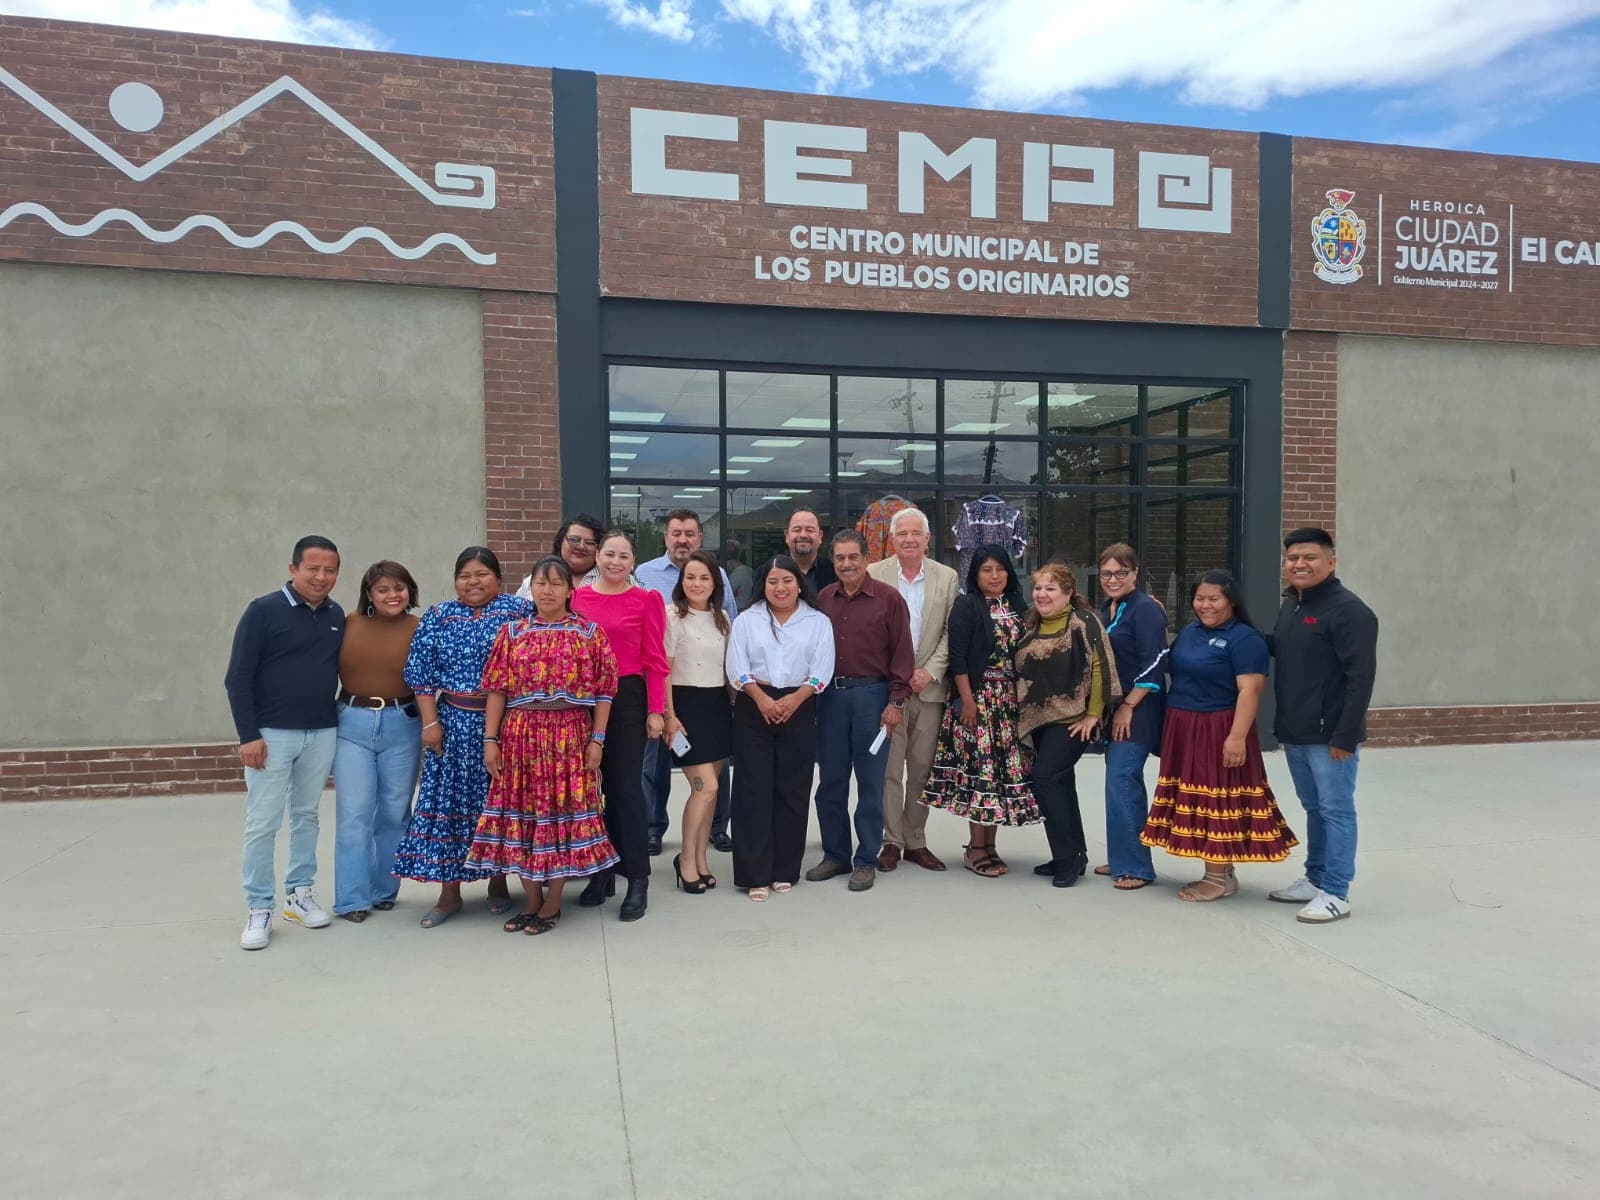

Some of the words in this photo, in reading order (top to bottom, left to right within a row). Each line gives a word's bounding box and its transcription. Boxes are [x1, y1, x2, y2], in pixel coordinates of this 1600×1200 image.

[630, 107, 1233, 234] CEMPO
[1410, 199, 1486, 216] HEROICA
[789, 224, 905, 255] CENTRO
[912, 232, 1059, 264] MUNICIPAL
[1064, 241, 1100, 266] DE
[1395, 216, 1499, 246] CIUDAD
[1394, 242, 1499, 275] JUÁREZ
[754, 255, 812, 282] LOS
[824, 259, 951, 290] PUEBLOS
[957, 267, 1131, 298] ORIGINARIOS
[1393, 275, 1425, 286] Gobierno
[1425, 277, 1458, 289] Municipal
